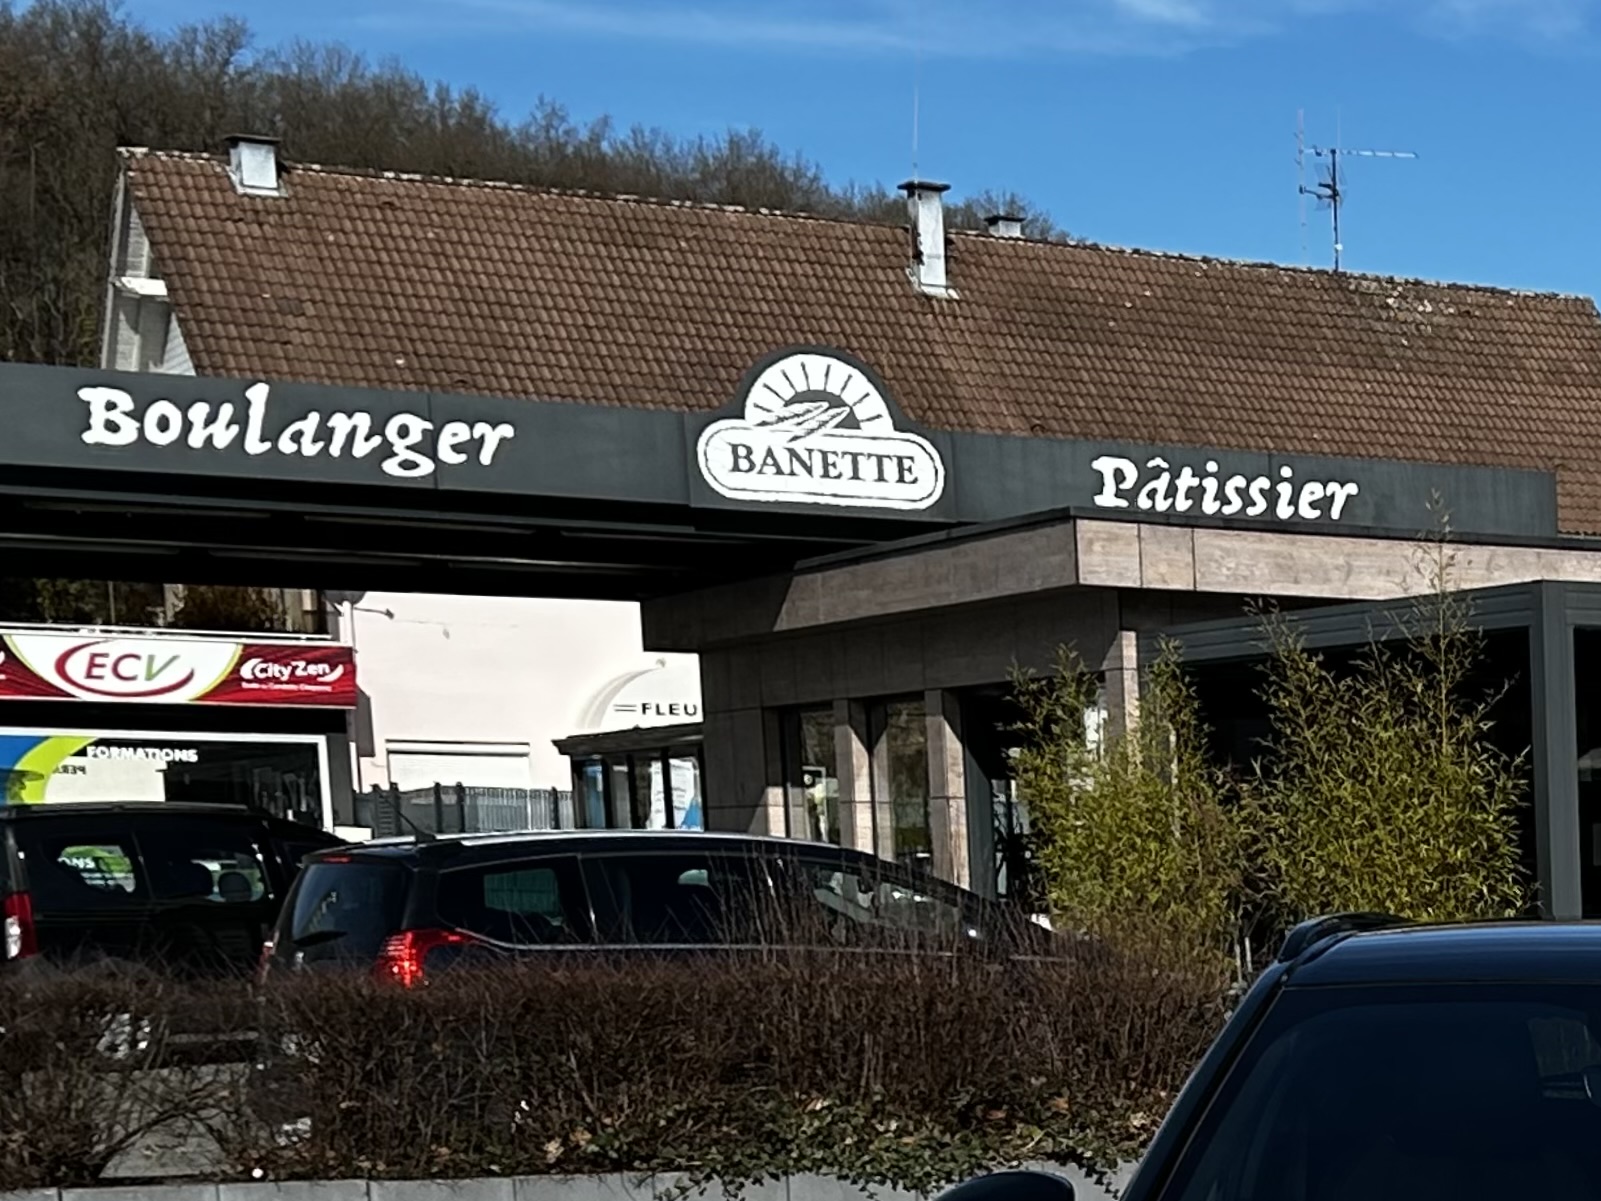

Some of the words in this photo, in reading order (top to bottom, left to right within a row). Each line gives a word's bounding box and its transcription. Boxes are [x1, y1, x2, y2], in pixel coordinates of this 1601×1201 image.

[77, 383, 514, 477] Boulanger
[727, 443, 919, 486] BANETTE
[1091, 456, 1360, 521] Pâtissier
[84, 652, 181, 682] ECV
[86, 746, 199, 763] FORMATIONS
